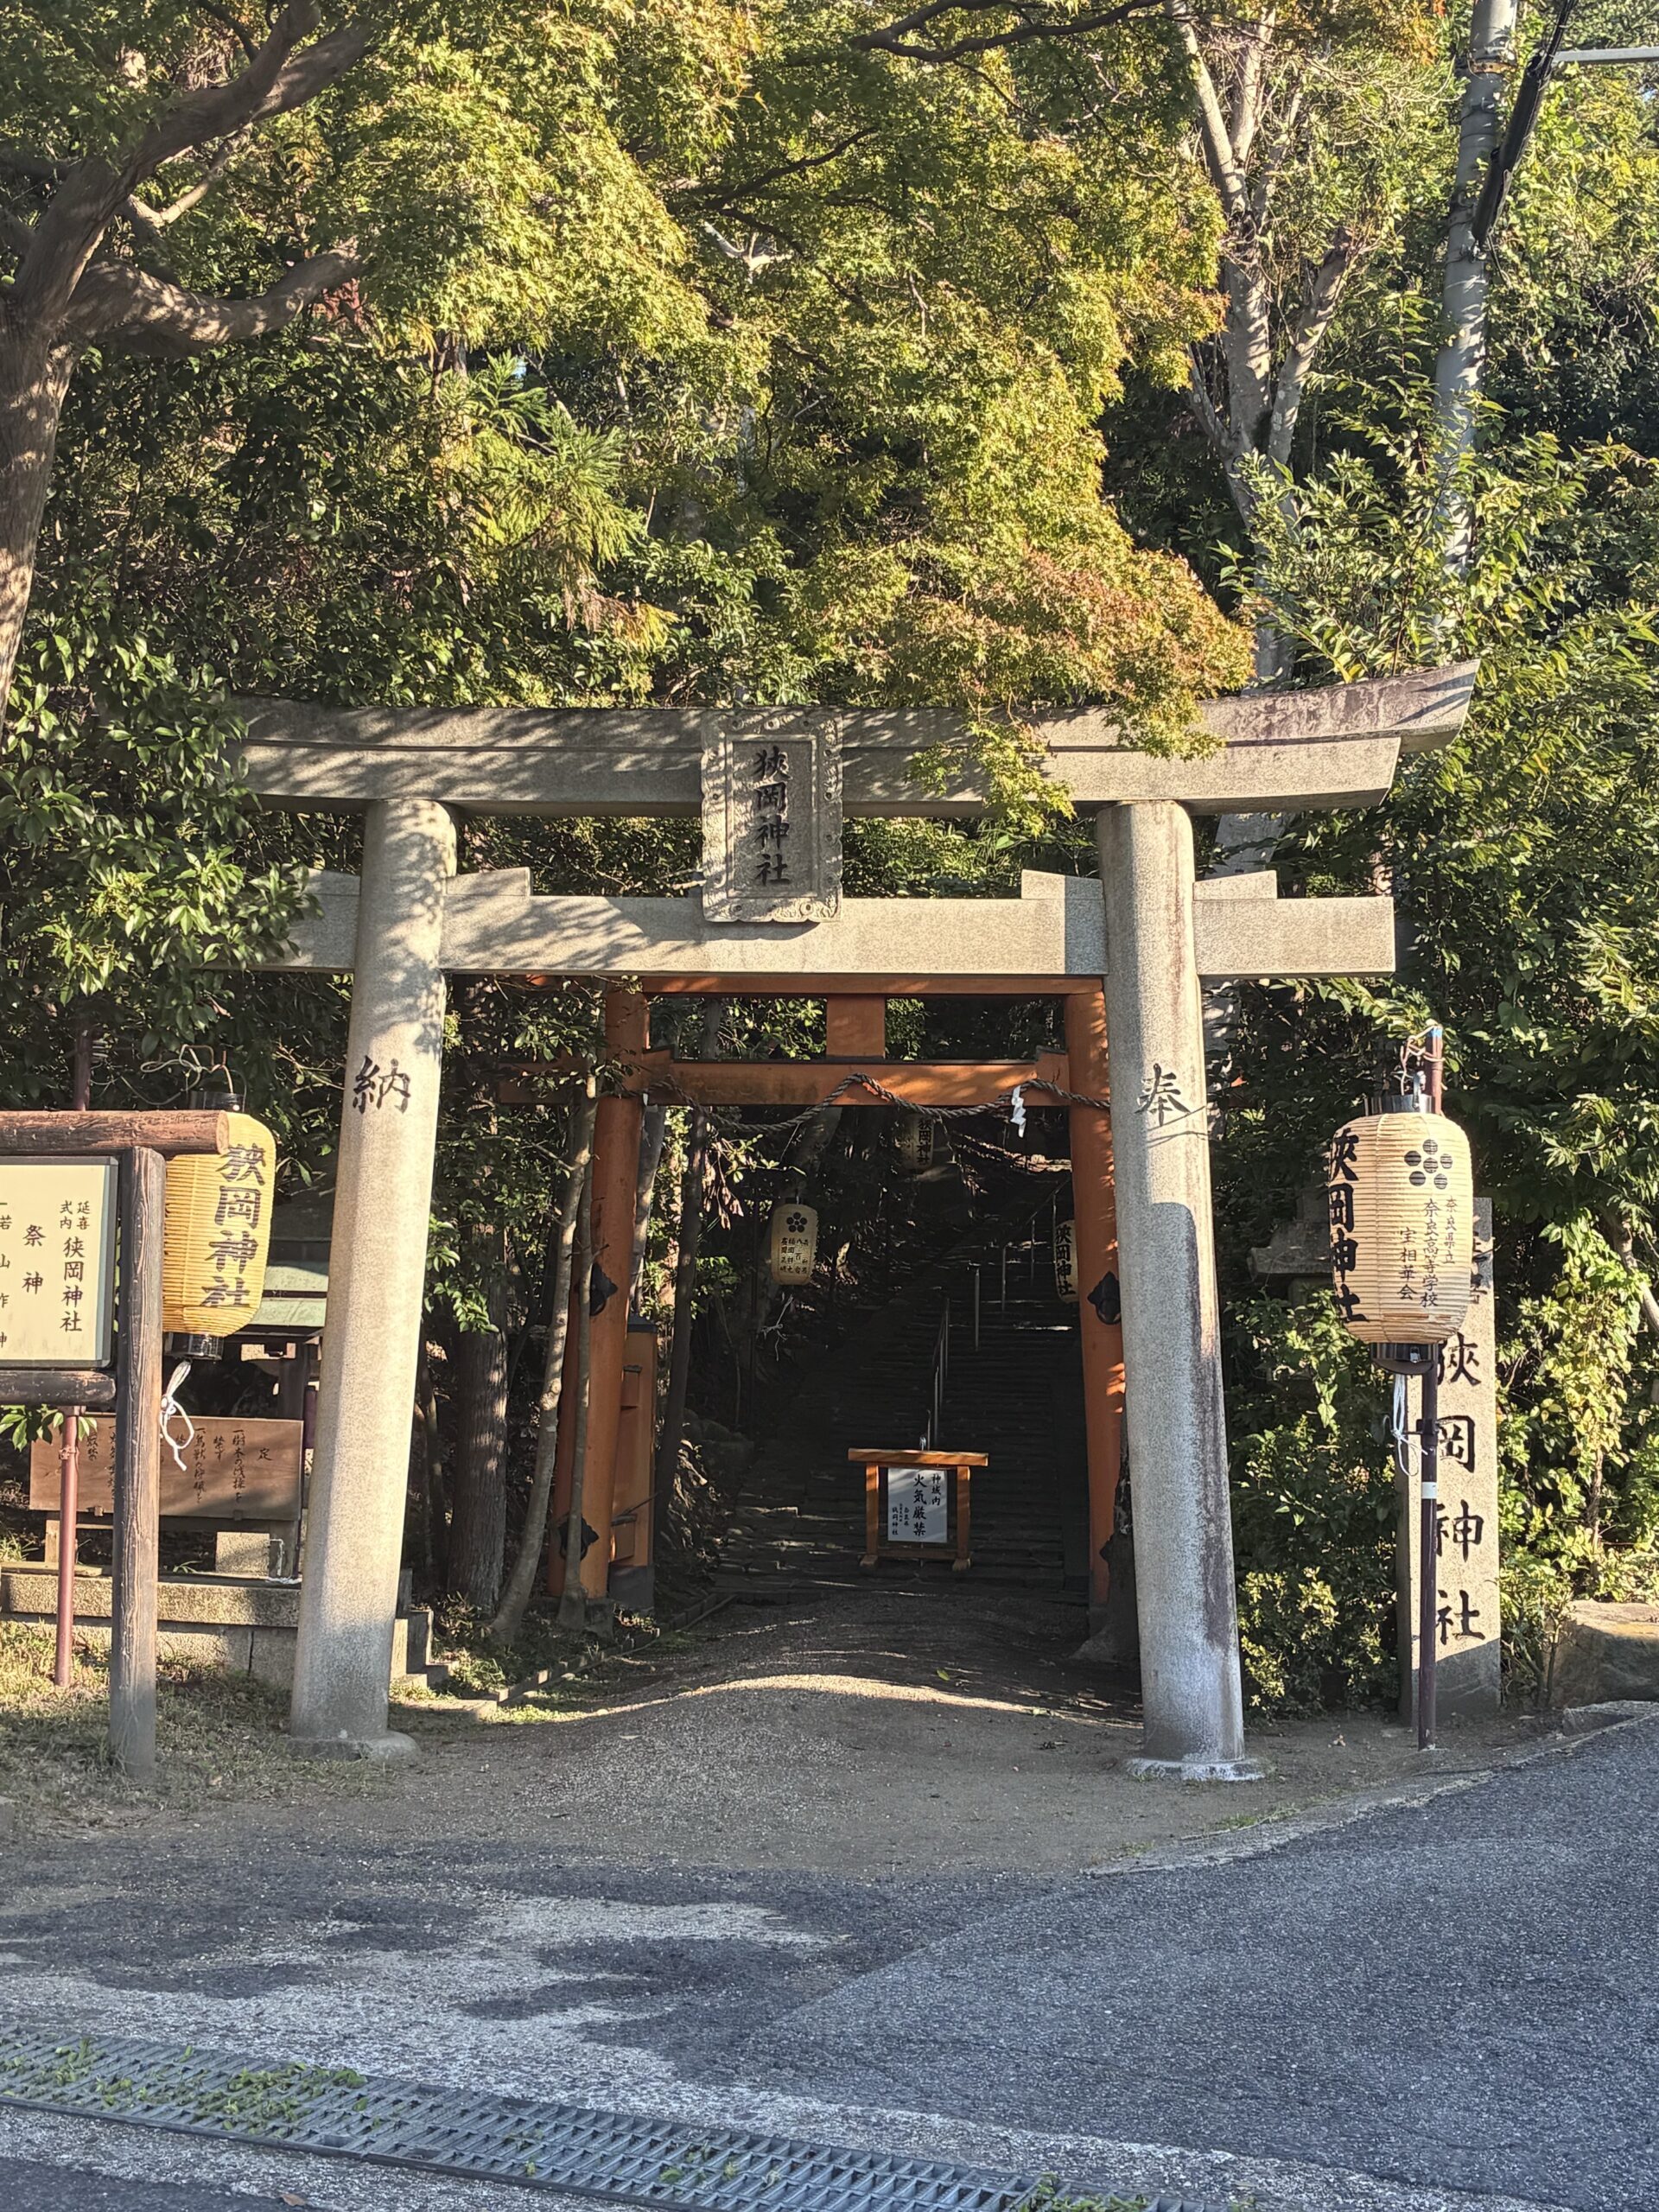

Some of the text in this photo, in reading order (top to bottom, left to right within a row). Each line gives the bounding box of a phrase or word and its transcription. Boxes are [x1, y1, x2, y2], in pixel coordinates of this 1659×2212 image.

[353, 1055, 411, 1114] 納
[1135, 1063, 1191, 1127] 奉
[60, 1200, 73, 1230] 式内
[77, 1200, 90, 1230] 延喜
[1443, 1195, 1458, 1264] 奈良県立
[22, 1224, 46, 1294] 祭神
[60, 1236, 86, 1332] 狭岡神社
[1420, 1198, 1440, 1307] 奈良高等学校
[257, 1448, 272, 1461] 定
[912, 1473, 927, 1536] 火気厳禁
